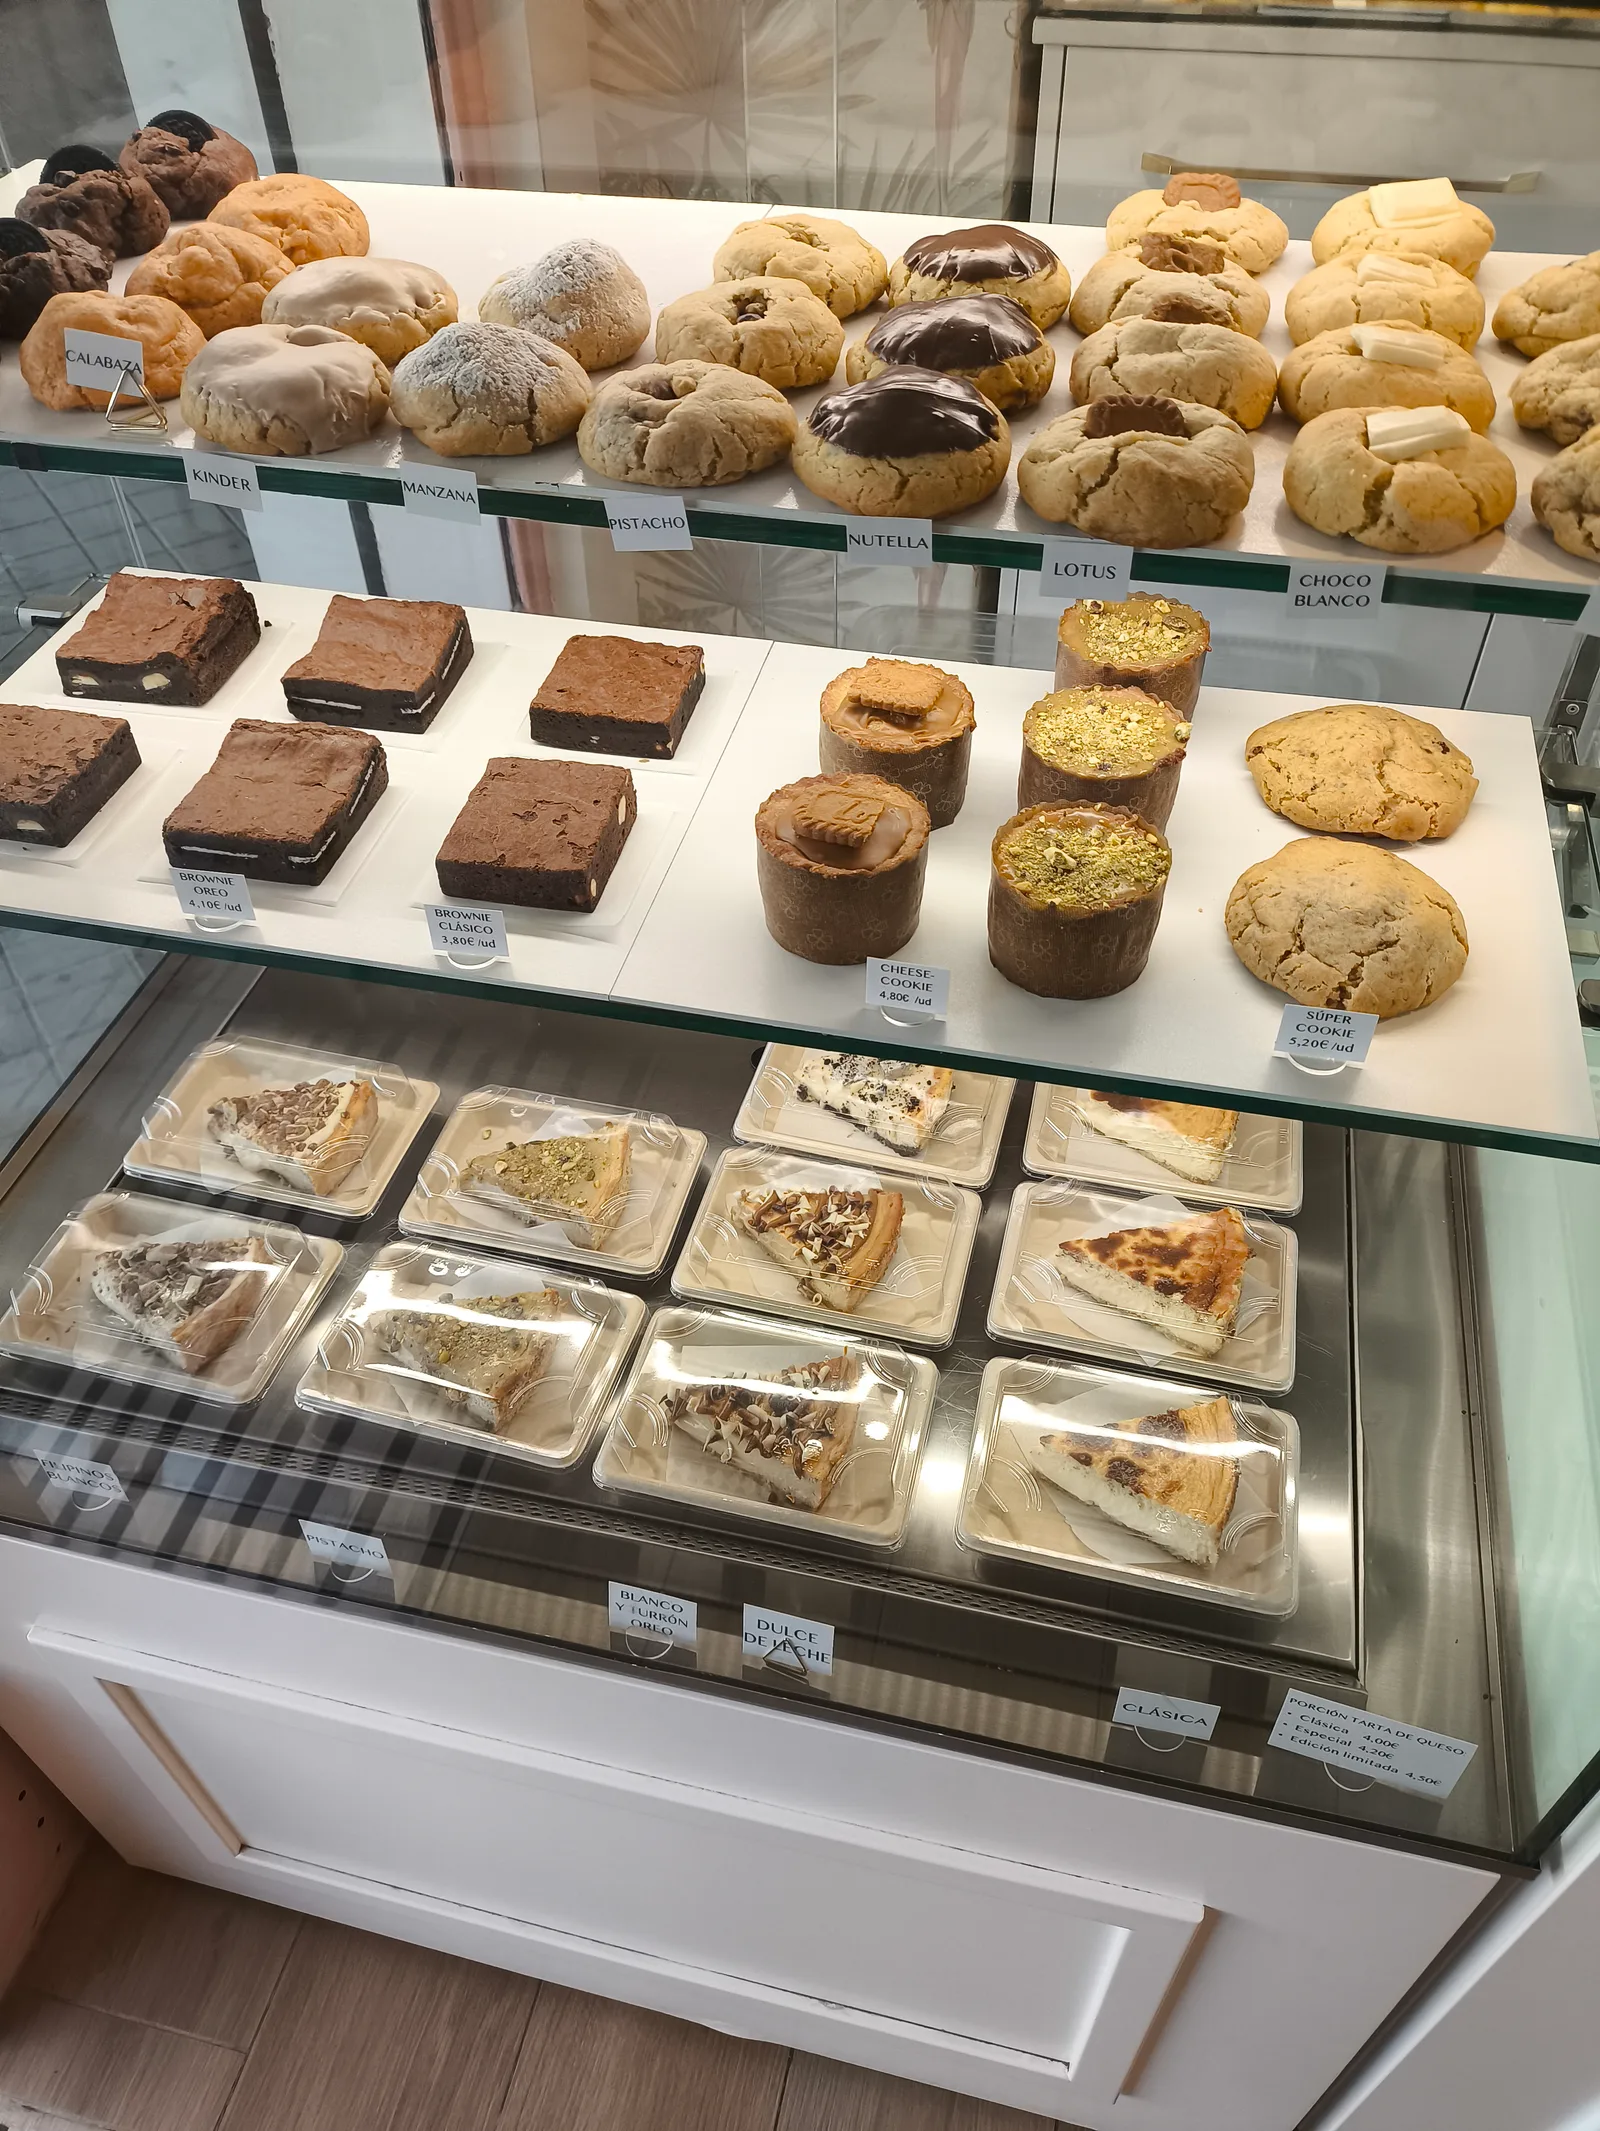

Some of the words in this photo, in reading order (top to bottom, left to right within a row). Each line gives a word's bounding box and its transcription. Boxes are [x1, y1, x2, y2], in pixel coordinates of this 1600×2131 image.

[66, 349, 142, 374] CALABAZA
[192, 468, 252, 492] KINDER
[403, 480, 476, 504] MANZANA
[608, 516, 686, 530] PISTACHO
[848, 534, 929, 549] NUTELLA
[1054, 562, 1116, 580] LOTUS
[1300, 574, 1372, 588] CHOCO
[1294, 594, 1370, 608] BLANCO
[180, 872, 236, 886] BROWNIE
[194, 886, 228, 898] OREO
[188, 900, 222, 910] 4,10€
[224, 902, 242, 912] /ud
[434, 908, 492, 922] BROWNIE
[438, 921, 494, 934] CLÁSICO
[442, 936, 475, 946] 3,80€
[478, 939, 496, 948] /ud
[880, 964, 935, 979] CHEESE-
[880, 976, 933, 992] COOKIE
[879, 990, 910, 1002] 4,80€
[914, 996, 932, 1006] /ud
[1306, 1010, 1352, 1024] SÚPER
[1296, 1023, 1356, 1038] COOKIE
[1288, 1036, 1330, 1050] 5,20€
[1331, 1042, 1354, 1053] /ud
[40, 1458, 114, 1482] FILIPINOS
[46, 1470, 122, 1494] BLANCOS
[306, 1534, 384, 1559] PISTACHO
[615, 1602, 625, 1611] Y
[620, 1590, 684, 1614] BLANCO
[630, 1618, 674, 1636] OREO
[757, 1618, 818, 1644] DULCE
[744, 1632, 768, 1648] DE
[772, 1640, 831, 1665] LECHE
[1122, 1703, 1208, 1726] CLÁSICA
[1289, 1697, 1348, 1720] PORCIÓN
[1352, 1716, 1392, 1735] TARTA
[1395, 1730, 1414, 1740] DE
[1300, 1714, 1349, 1735] Clásica
[1362, 1734, 1400, 1750] 4.00€
[1294, 1724, 1352, 1748] Especial
[1358, 1745, 1395, 1760] 4.20€
[1290, 1735, 1340, 1756] Edición
[1343, 1751, 1399, 1774] limitada
[1405, 1772, 1442, 1787] 4.50€
